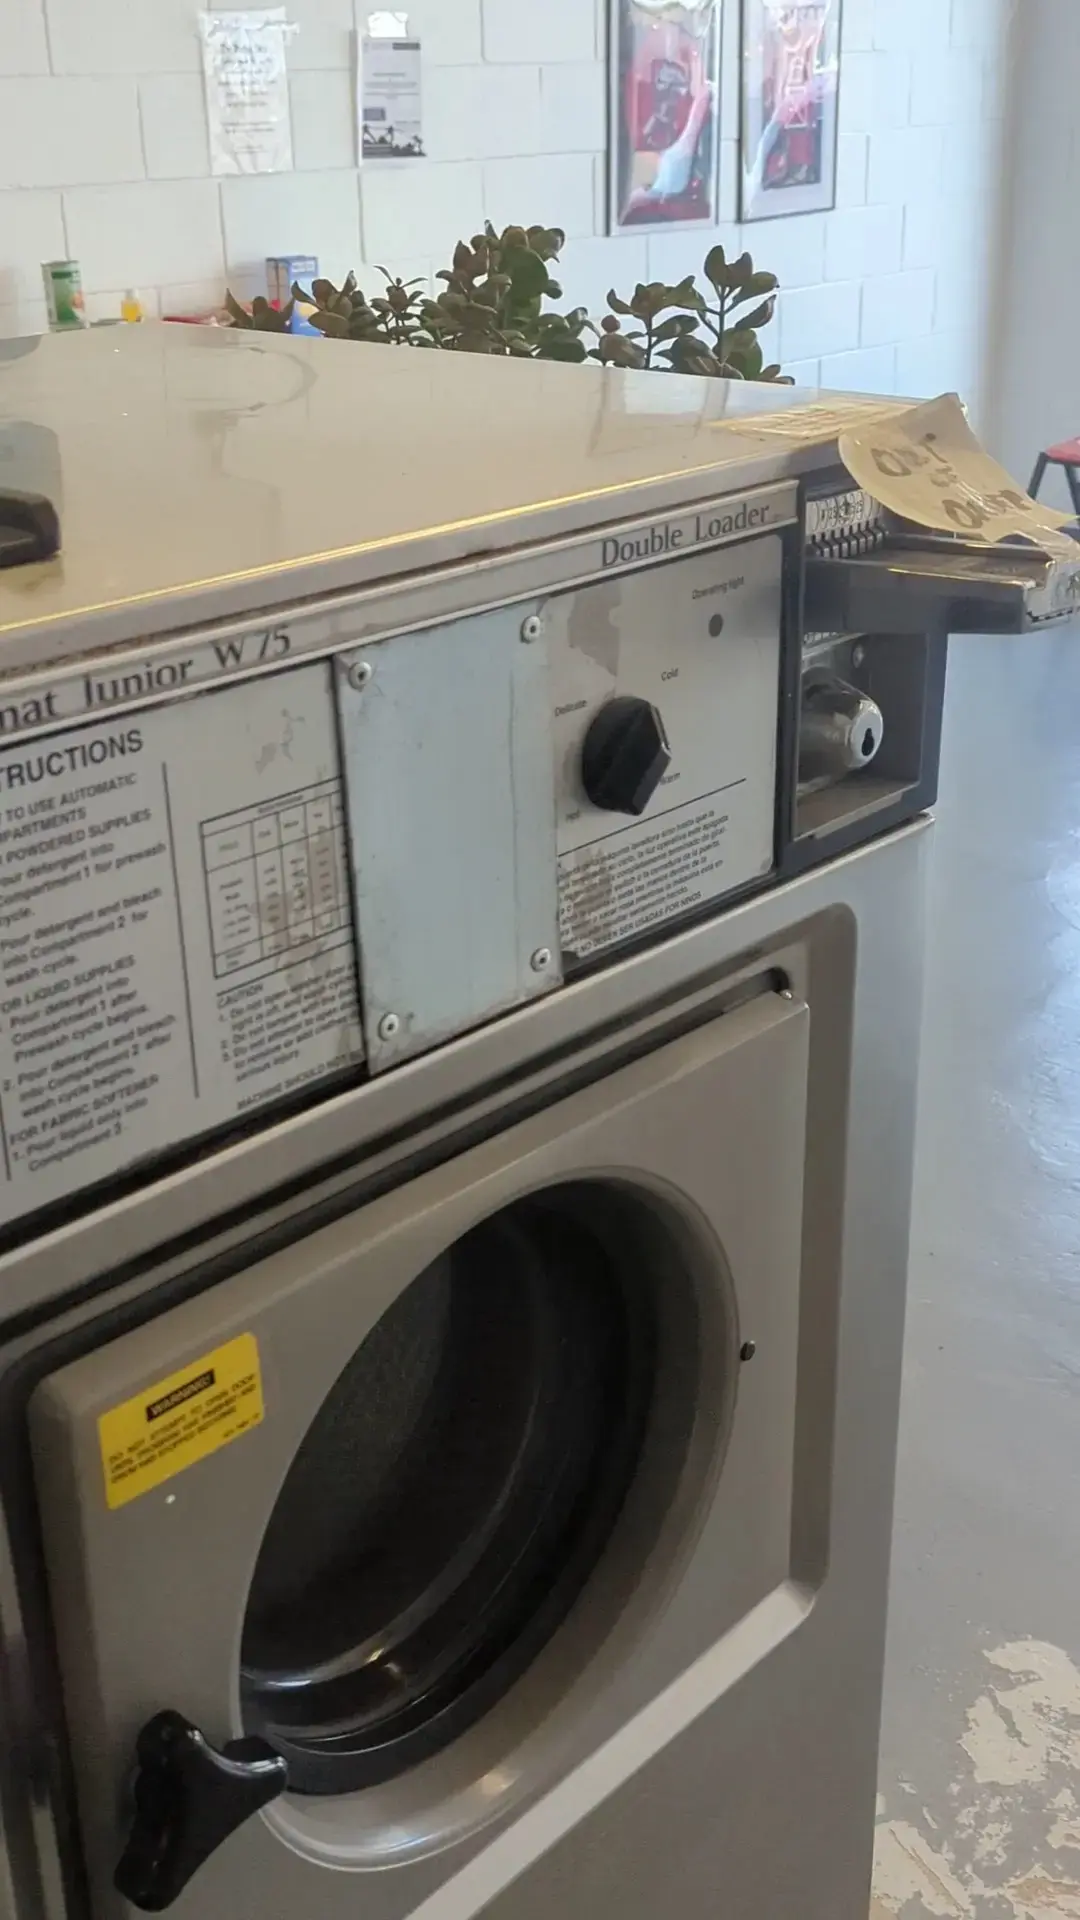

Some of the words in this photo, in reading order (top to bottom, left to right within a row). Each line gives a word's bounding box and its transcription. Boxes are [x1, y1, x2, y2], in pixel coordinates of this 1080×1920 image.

[602, 524, 683, 567] Double
[695, 503, 770, 541] Loader
[692, 580, 729, 600] Operating
[84, 658, 194, 708] Junior
[660, 667, 680, 682] Cold
[60, 772, 138, 806] AUTOMATIC
[660, 771, 681, 785] arm
[88, 808, 153, 838] SUPPLIES
[117, 914, 126, 929] 2
[73, 953, 136, 986] SUPPLIES
